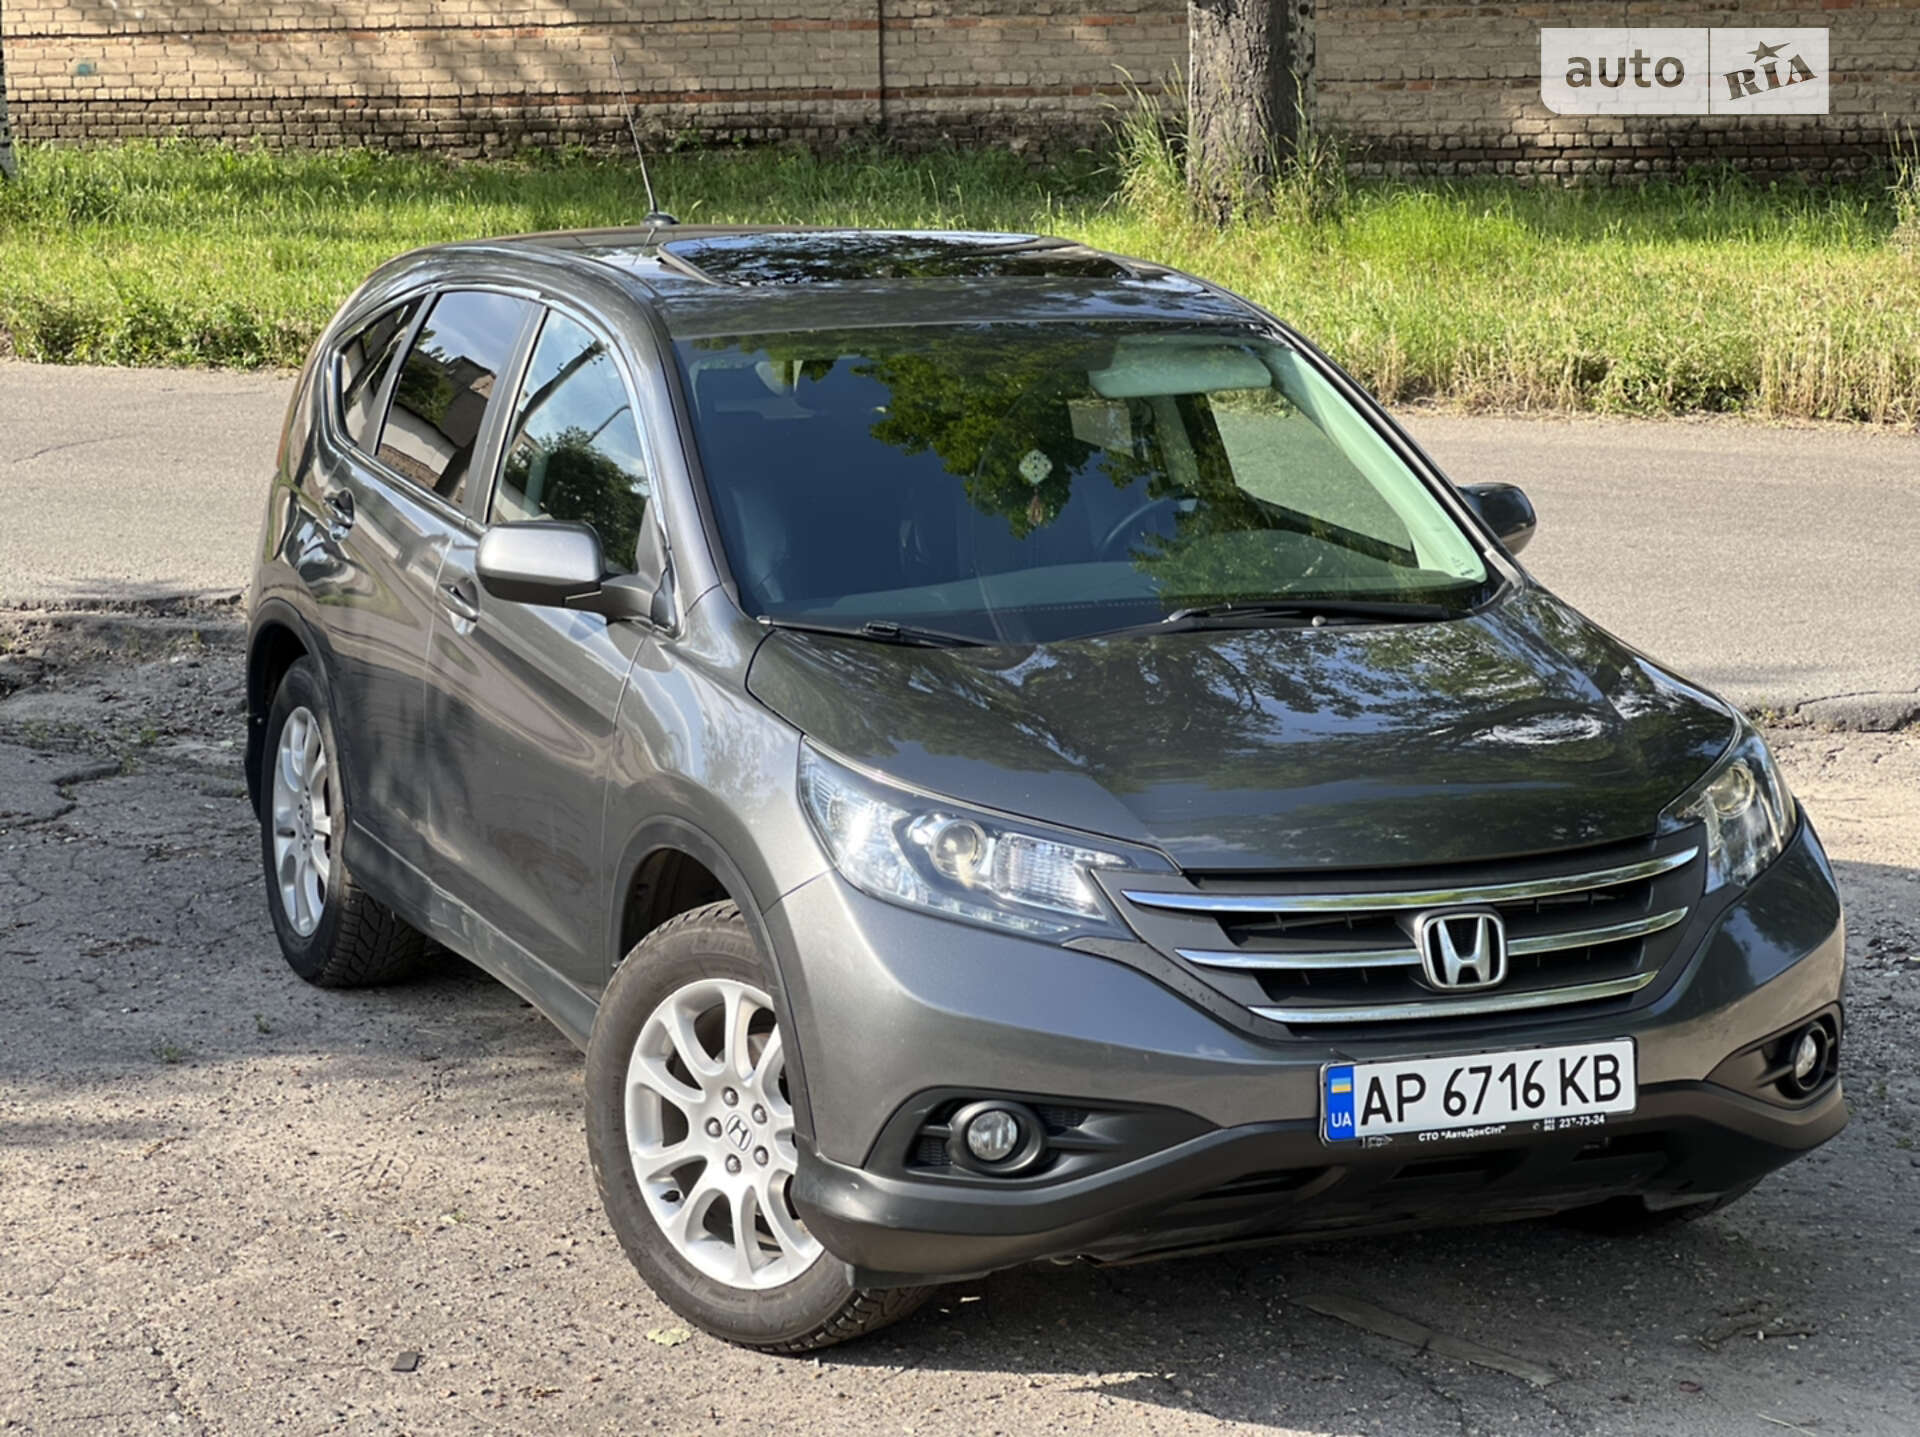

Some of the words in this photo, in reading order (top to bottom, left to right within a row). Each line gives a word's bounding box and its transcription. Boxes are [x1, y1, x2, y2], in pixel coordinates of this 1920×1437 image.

[1360, 1072, 1427, 1126] AP
[1442, 1059, 1546, 1117] 6716
[1558, 1053, 1622, 1107] KB
[1331, 1111, 1353, 1128] UA
